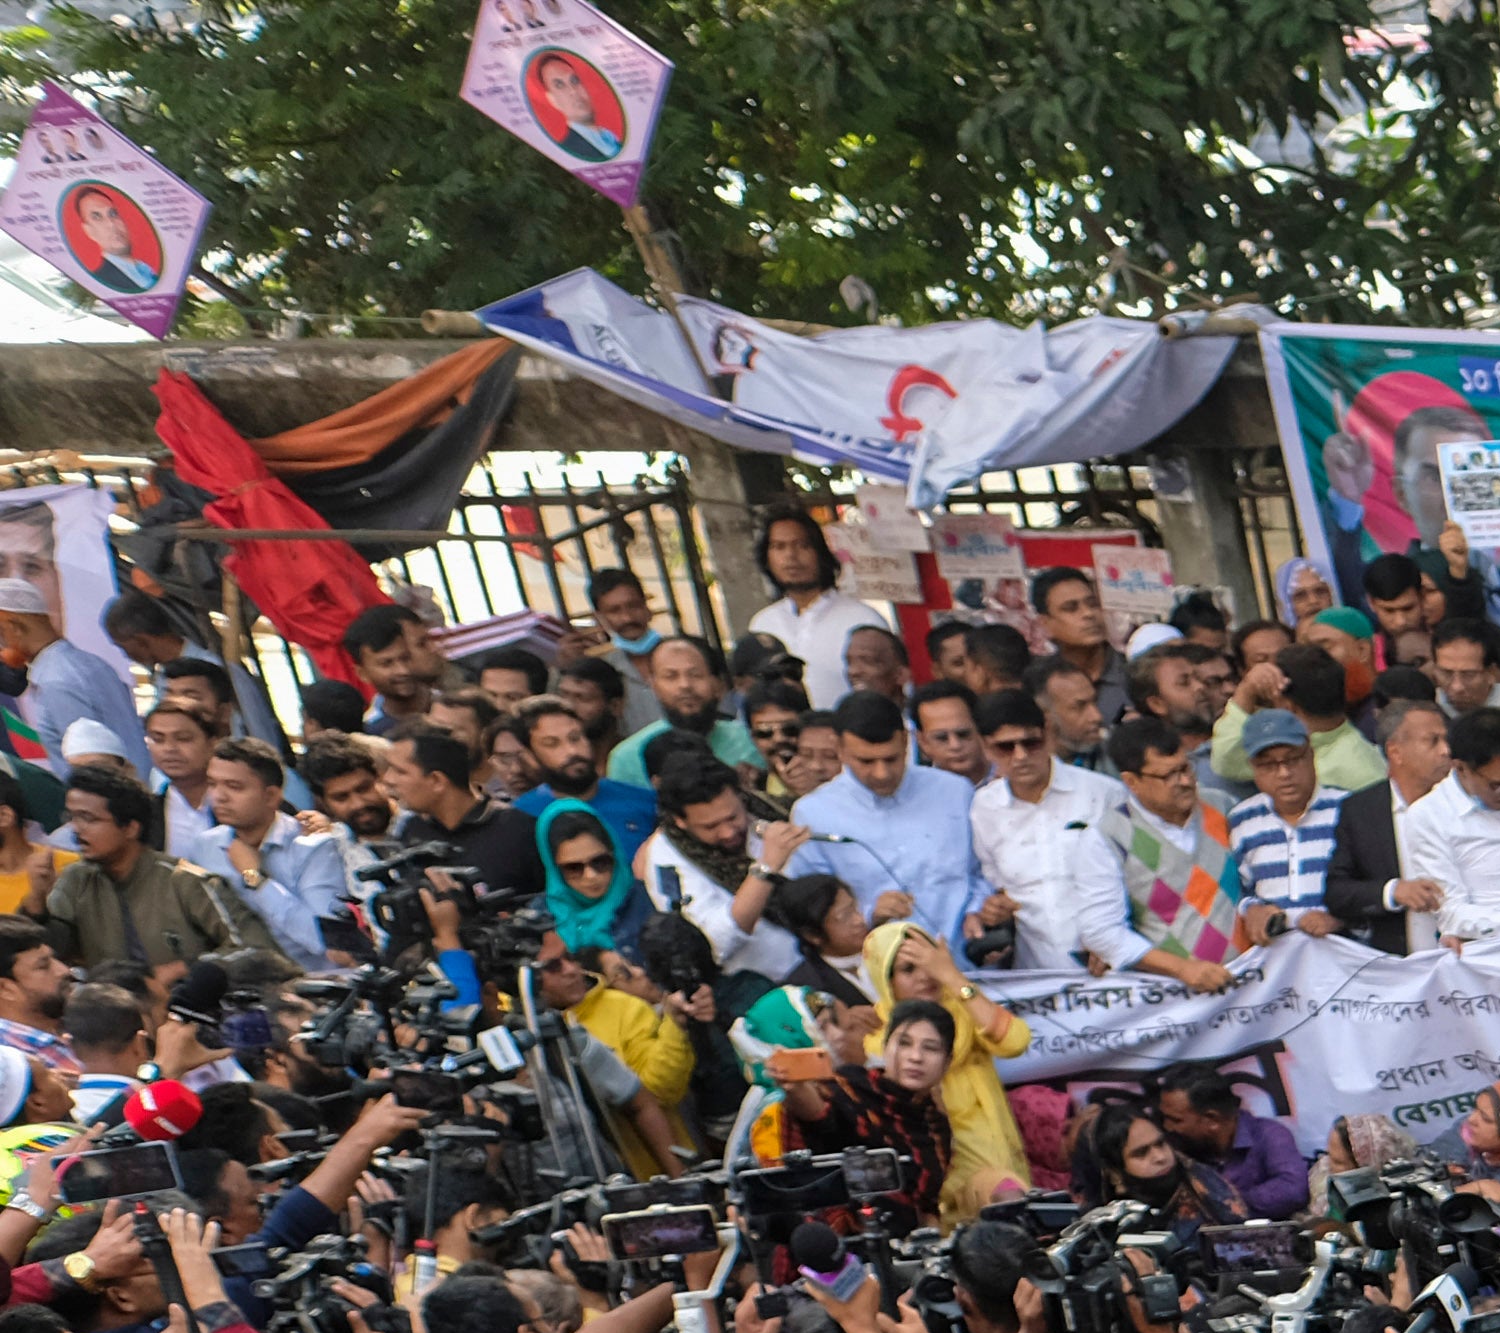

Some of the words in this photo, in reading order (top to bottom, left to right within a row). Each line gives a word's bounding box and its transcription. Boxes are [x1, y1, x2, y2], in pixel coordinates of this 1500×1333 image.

[1459, 367, 1490, 393] ১০
[1063, 982, 1134, 1014] দিবস
[1207, 988, 1300, 1030] নেতাকর্মী
[1376, 1056, 1447, 1091] প্রধান
[1394, 1091, 1479, 1127] বেগম
